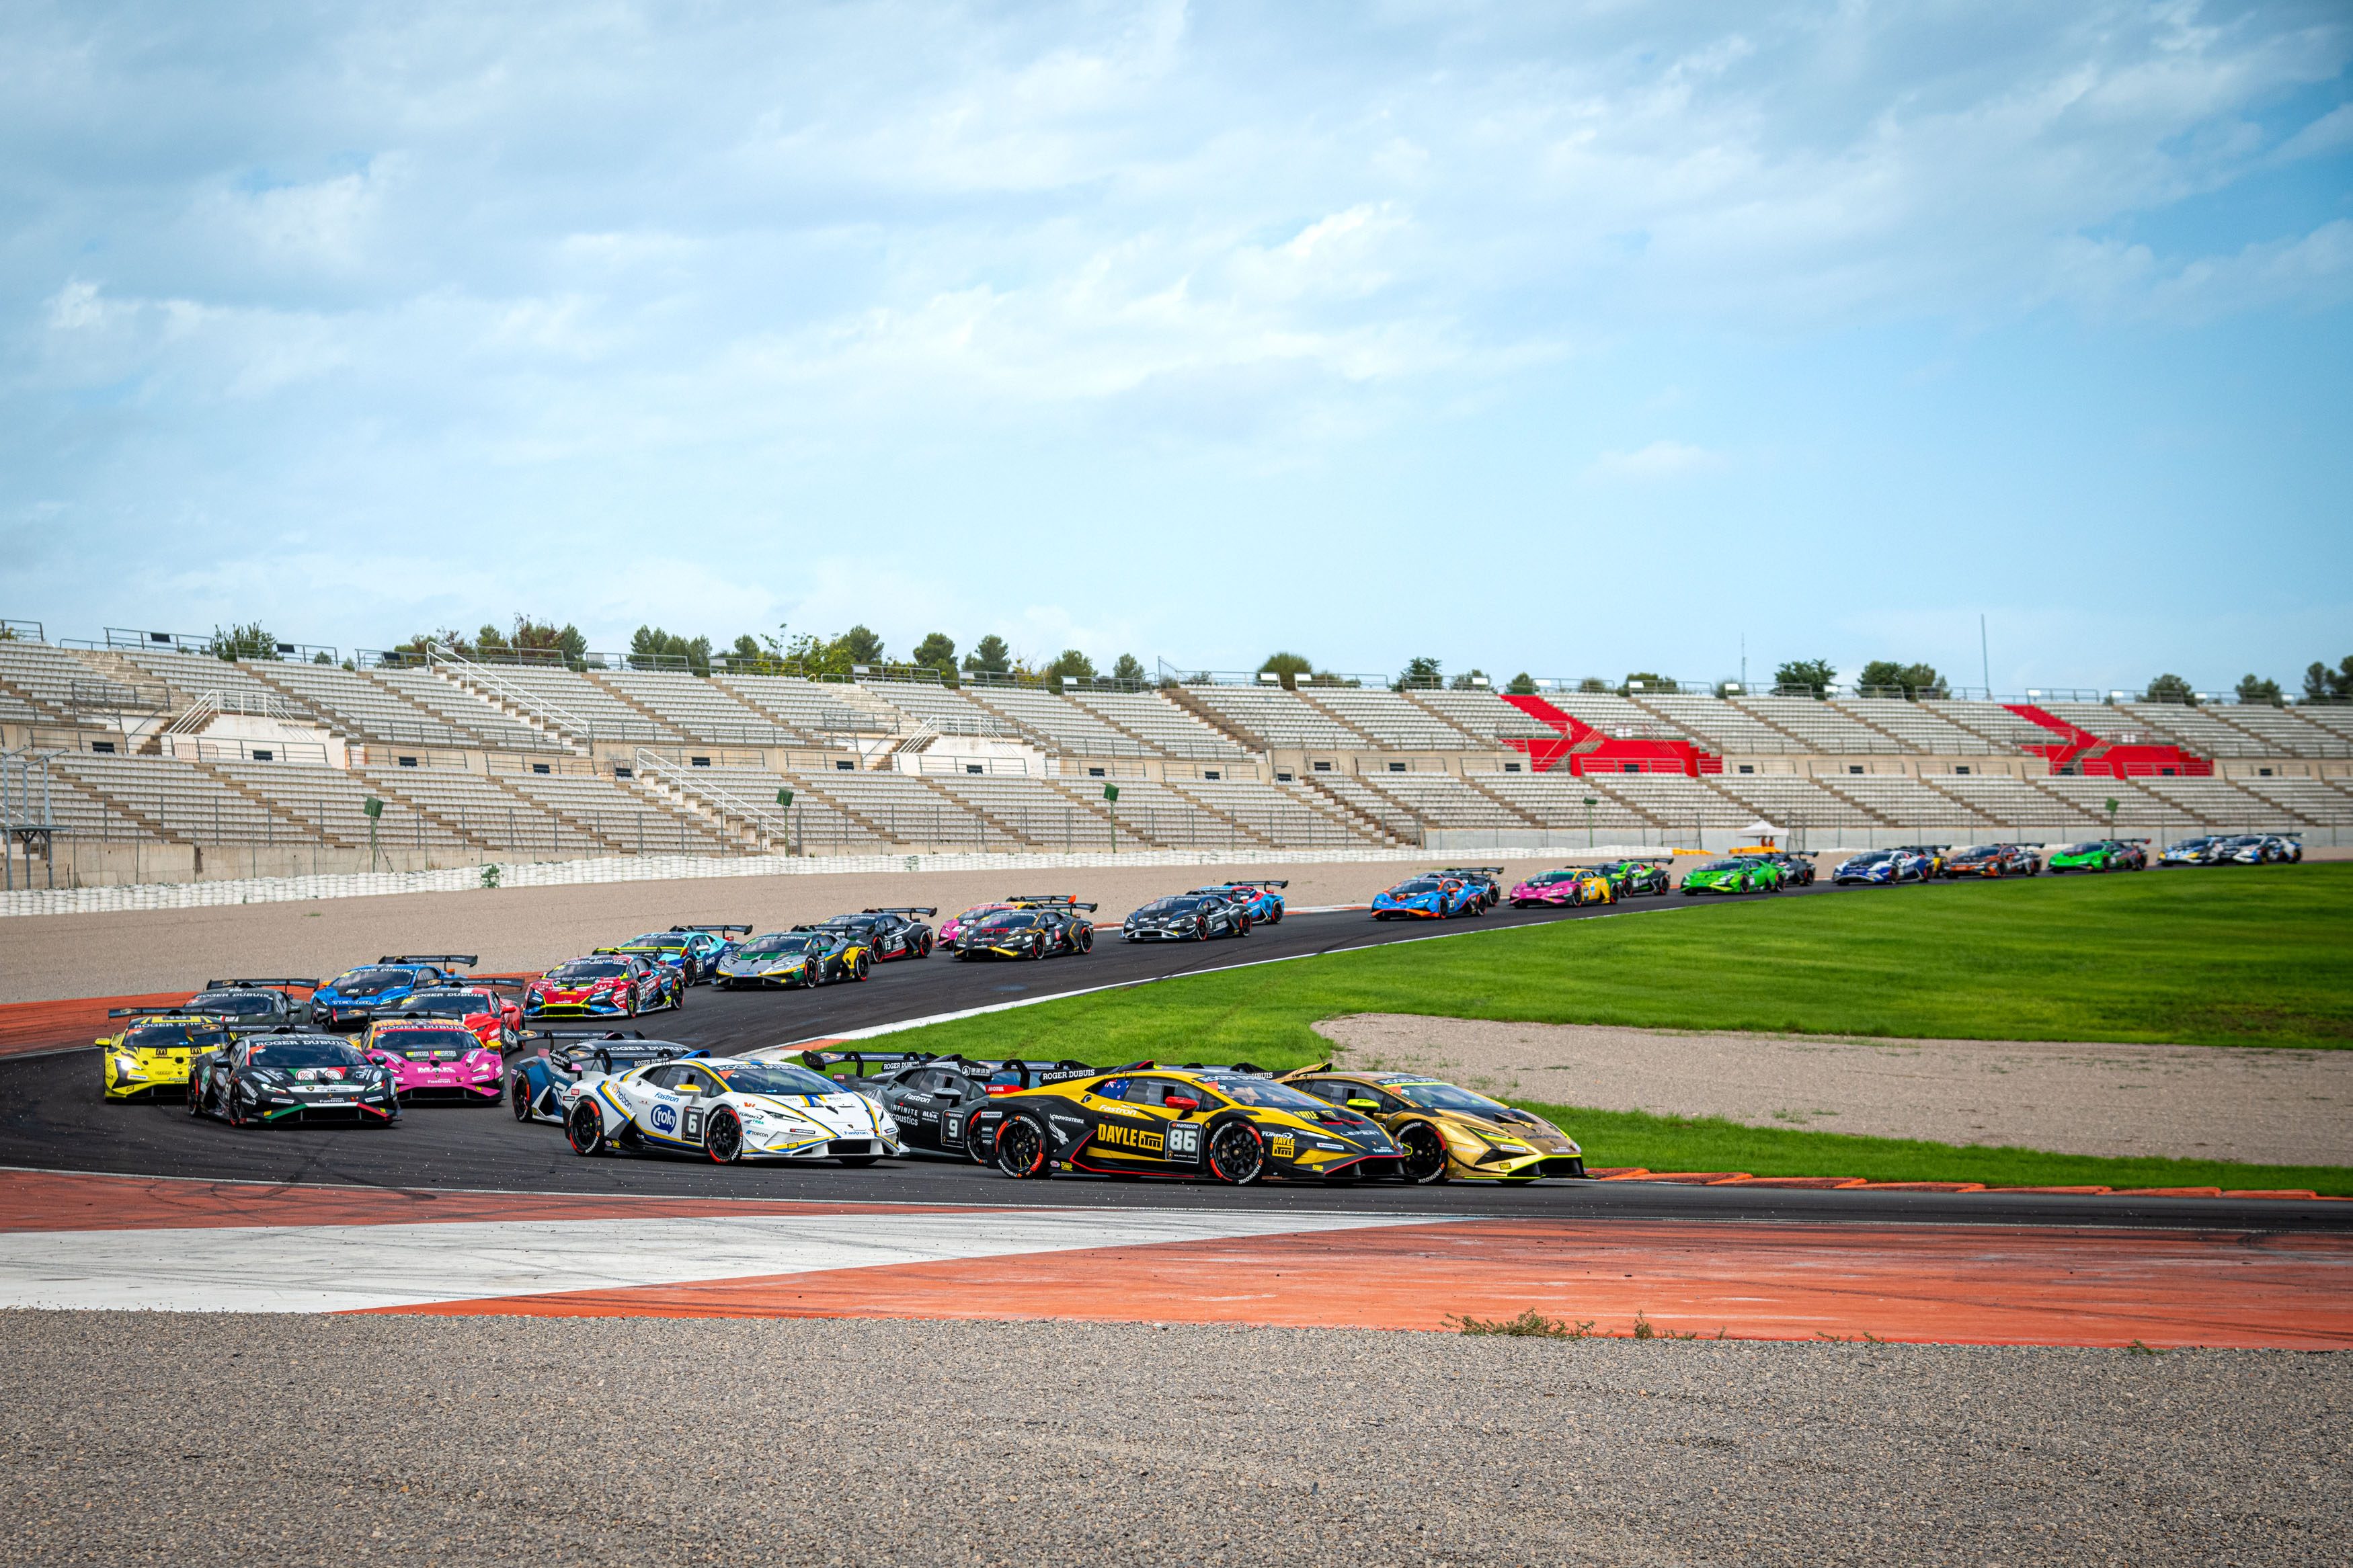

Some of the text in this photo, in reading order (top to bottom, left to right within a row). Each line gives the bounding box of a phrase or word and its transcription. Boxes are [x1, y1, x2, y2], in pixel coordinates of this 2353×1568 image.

[885, 940, 891, 950] 13
[696, 961, 703, 973] 21
[820, 962, 824, 973] 2
[634, 1059, 651, 1067] ROGER
[883, 1062, 901, 1070] ROGER
[1043, 1069, 1095, 1080] ROGER DUBUIS
[654, 1091, 679, 1104] Fastron
[904, 1093, 932, 1104] Fastron
[890, 1104, 918, 1116] INFINITE
[1098, 1104, 1138, 1116] Fastron
[1295, 1110, 1319, 1120] DAYLE
[651, 1106, 676, 1128] Croky
[1051, 1114, 1085, 1124] CROWDSTRIKE
[688, 1114, 697, 1133] 6
[949, 1118, 959, 1139] 9
[751, 1130, 769, 1139] TOPCON
[1097, 1123, 1138, 1148] DAYLE
[1168, 1128, 1198, 1153] 86
[1273, 1137, 1296, 1147] DAYLE
